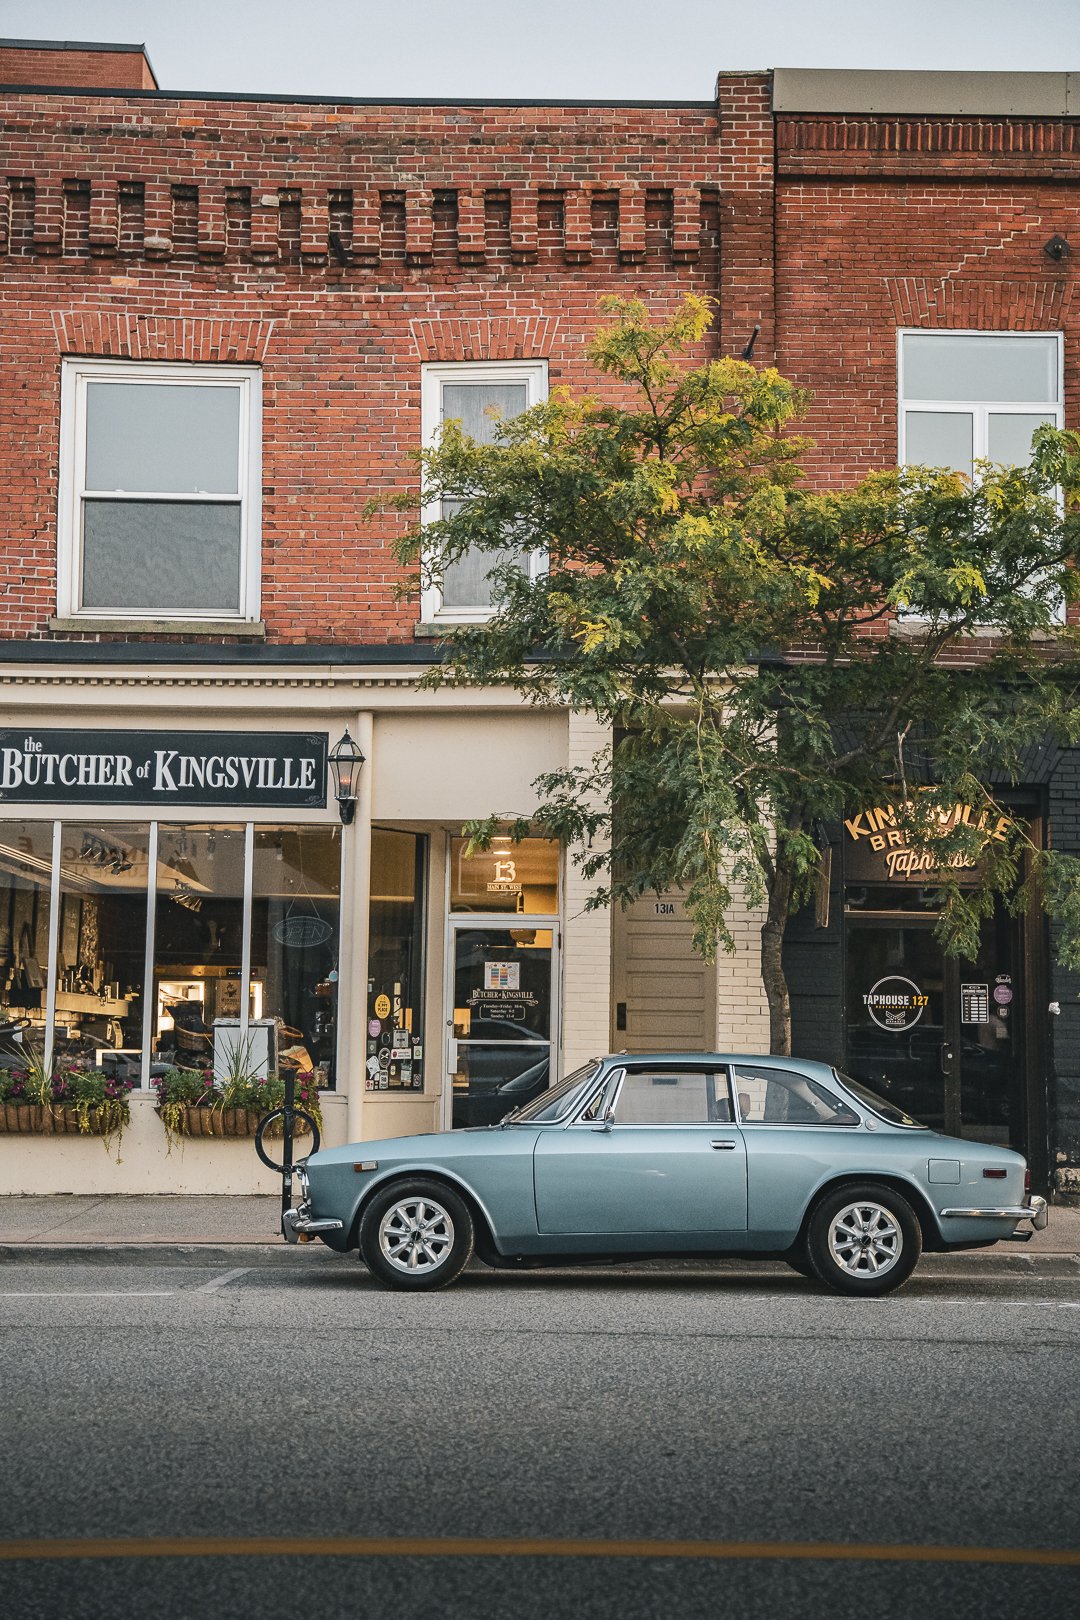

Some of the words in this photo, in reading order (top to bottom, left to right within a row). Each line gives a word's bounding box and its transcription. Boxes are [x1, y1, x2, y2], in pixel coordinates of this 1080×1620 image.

[24, 736, 43, 752] the
[0, 748, 133, 789] BUTCHER
[136, 760, 151, 778] of
[152, 750, 316, 791] KINGSVILLE
[493, 860, 516, 882] 13
[472, 989, 499, 999] BUTCHER
[501, 990, 534, 999] KINGSVILLE
[862, 994, 910, 1006] TAPHOUSE
[912, 995, 929, 1006] 127
